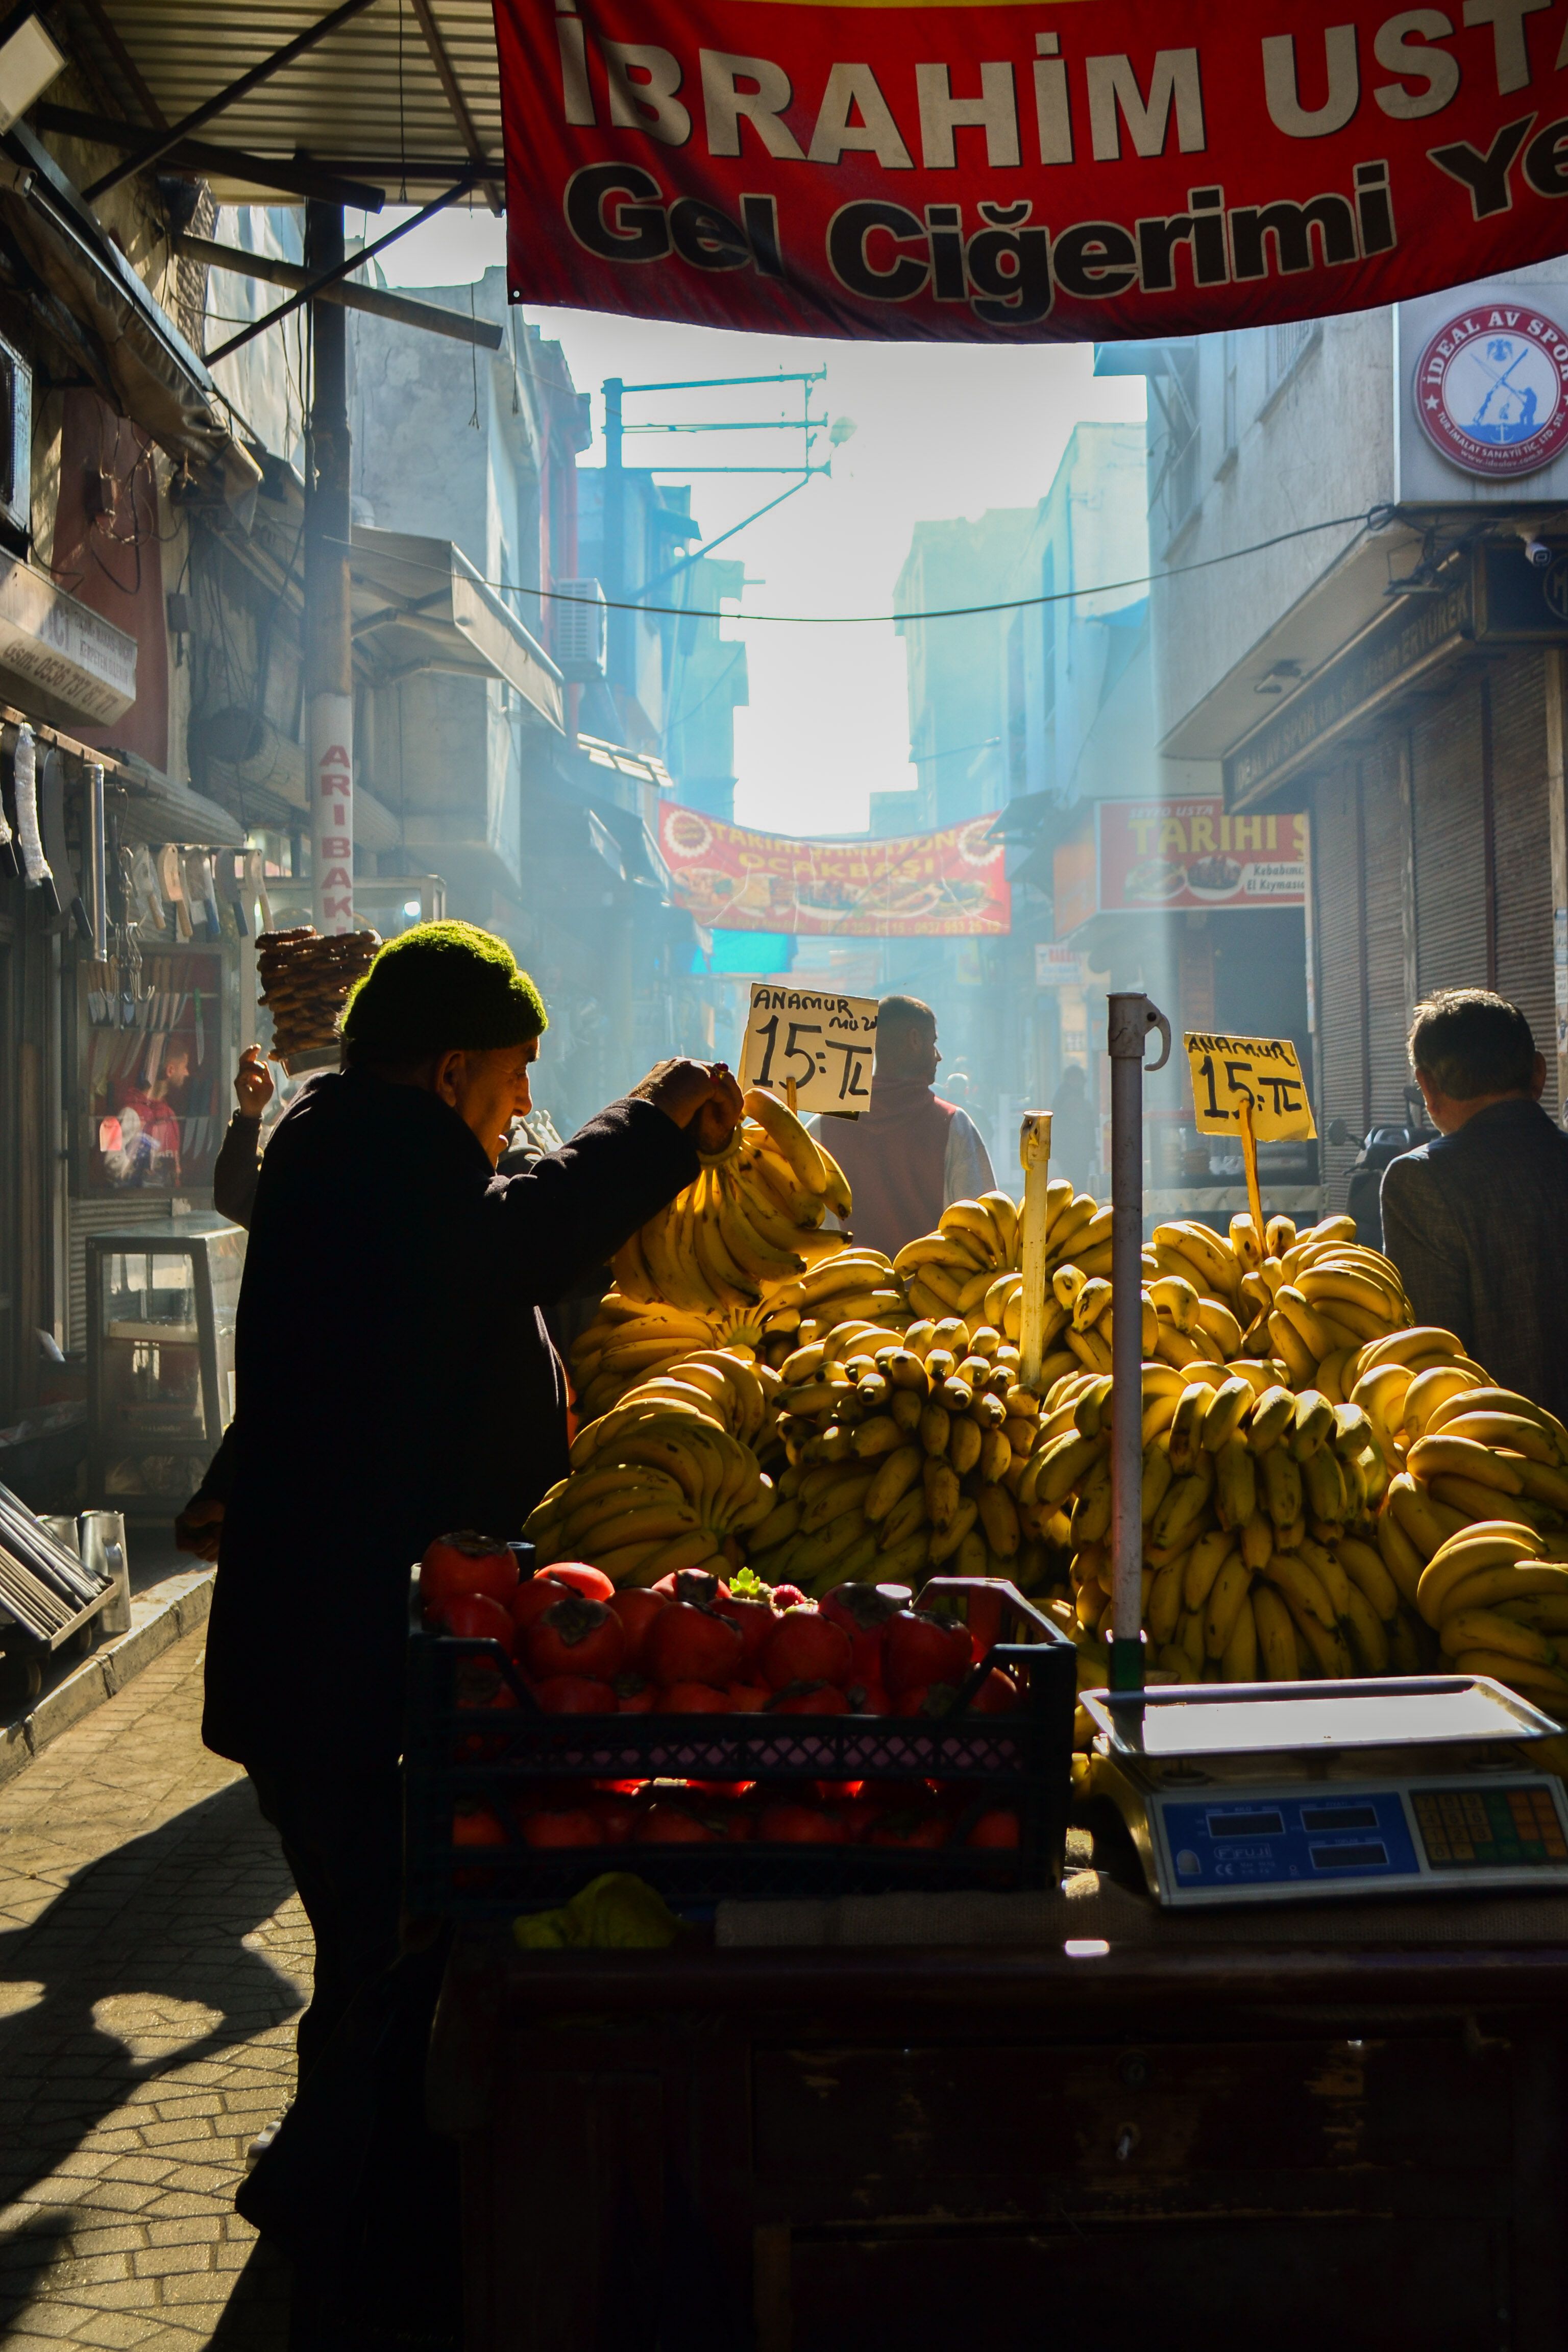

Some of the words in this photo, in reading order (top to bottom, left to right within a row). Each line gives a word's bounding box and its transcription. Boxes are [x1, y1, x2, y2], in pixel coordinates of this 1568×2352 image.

[554, 0, 1206, 169] İBRAHİM
[1262, 0, 1568, 138] UST
[564, 162, 783, 278] Gel
[826, 160, 1396, 325] Ciğerimi
[1422, 319, 1480, 384] İDEAL
[1488, 311, 1521, 328] AV
[1247, 879, 1256, 891] El
[752, 989, 854, 1019] ANAMUR
[1234, 1848, 1269, 1858] FUJI
